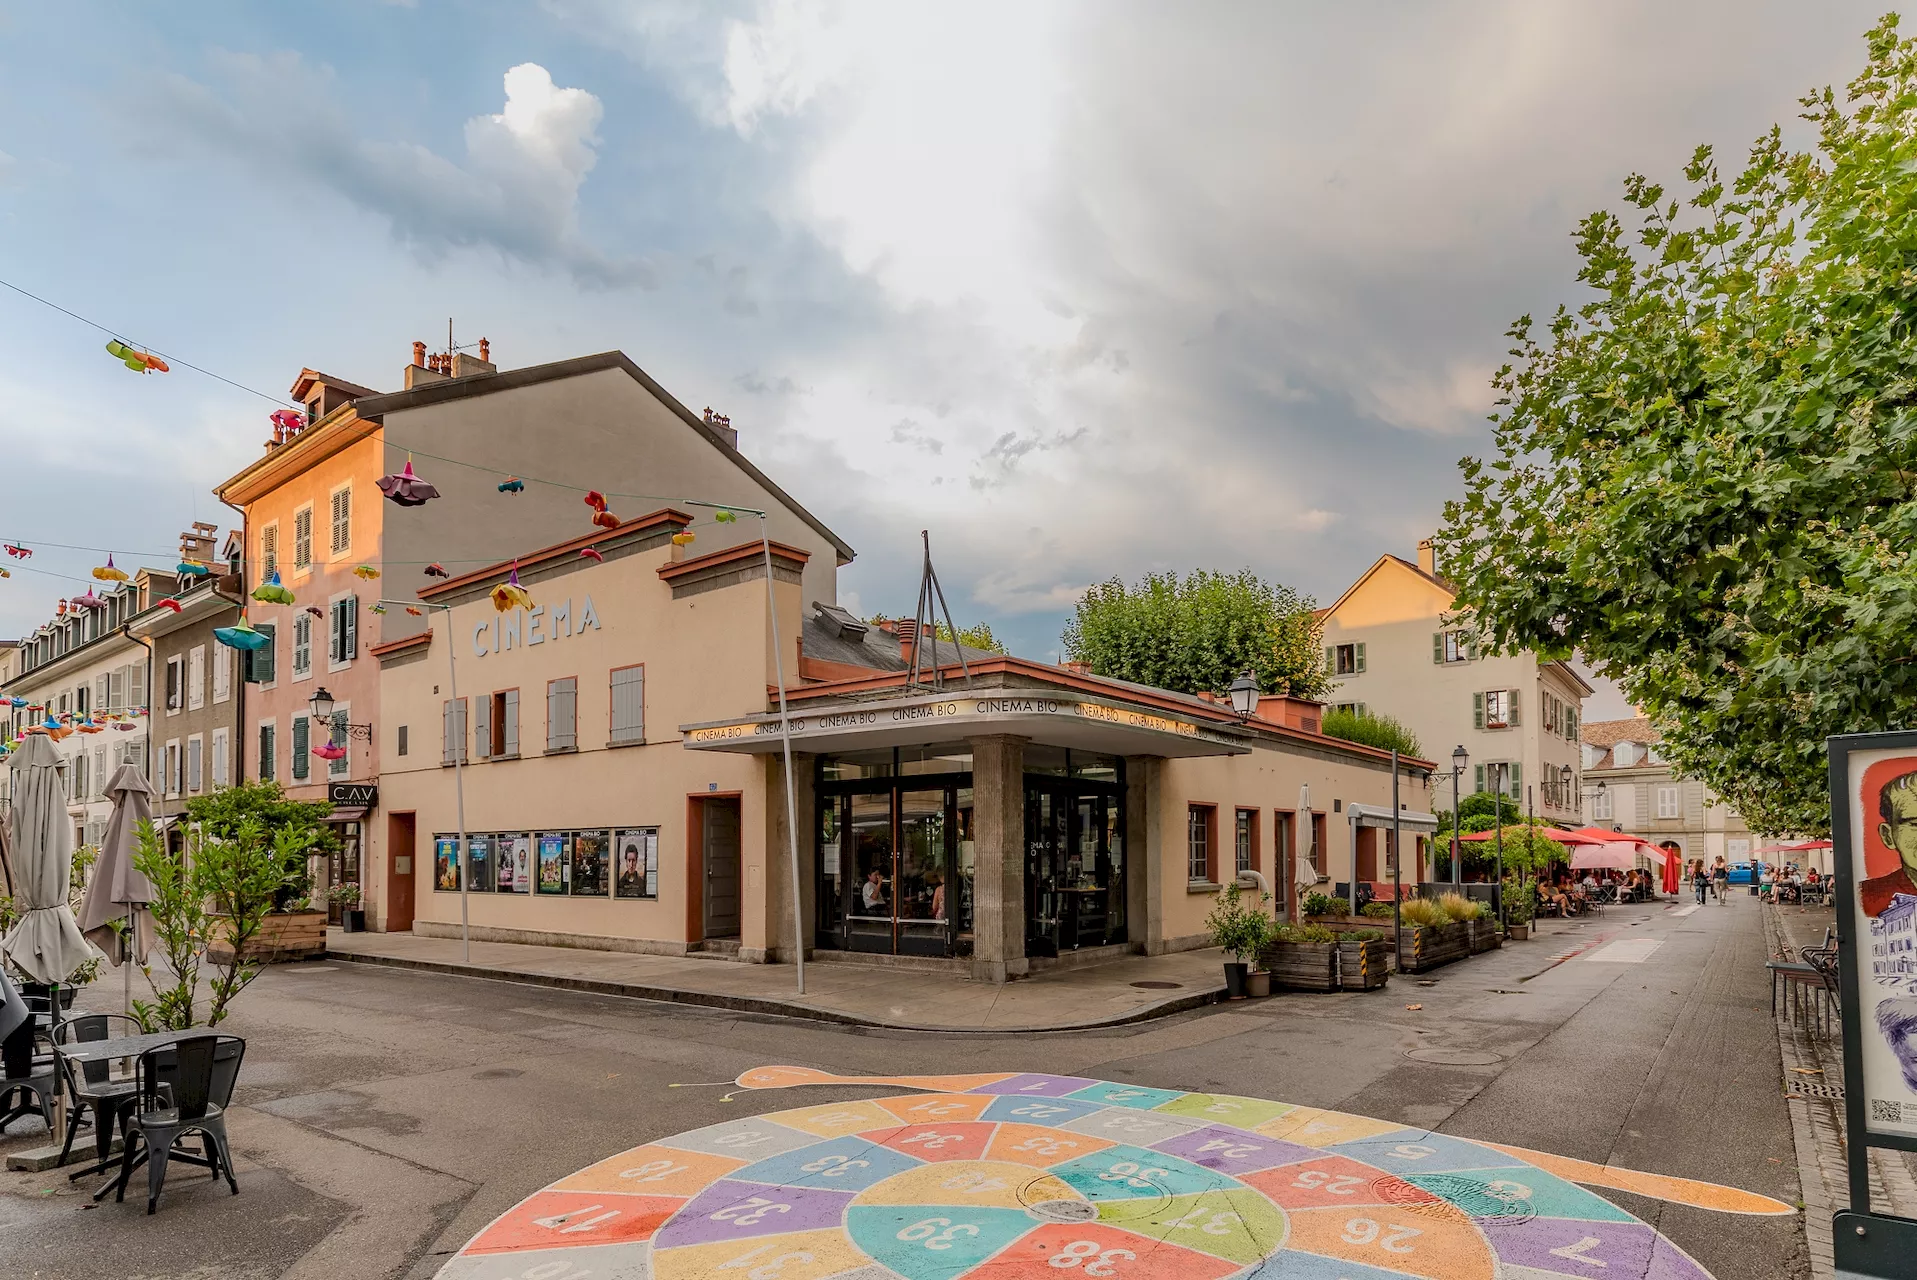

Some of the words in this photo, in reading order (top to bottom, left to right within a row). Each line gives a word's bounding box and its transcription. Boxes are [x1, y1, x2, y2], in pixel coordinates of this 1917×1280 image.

[472, 594, 601, 657] CINEMA
[892, 706, 934, 721] CINEMA
[937, 703, 957, 716] BIO
[975, 701, 1033, 714] CINEMA
[1037, 702, 1058, 713] BIO
[1073, 703, 1106, 719] CINEMA
[1106, 709, 1120, 722] BIO
[789, 720, 806, 731] BIO
[819, 715, 857, 728] CINEMA
[860, 712, 877, 724] BIO
[1128, 714, 1155, 730] CINEMA
[1155, 720, 1167, 731] BIO
[696, 729, 727, 742] CINEMA
[728, 727, 742, 738] BIO
[1020, 1081, 1050, 1091] 1
[1103, 1090, 1149, 1101] 2
[908, 1100, 970, 1115] 21
[1010, 1103, 1071, 1118] 22
[1203, 1102, 1243, 1114] 3
[1103, 1116, 1166, 1132] 23
[714, 1131, 776, 1148] 19
[899, 1130, 965, 1149] 34
[1011, 1136, 1078, 1155] 35
[1195, 1138, 1262, 1159] 24
[1385, 1144, 1437, 1161] 5
[618, 1160, 689, 1183] 18
[800, 1155, 870, 1177] 33
[1099, 1162, 1169, 1188] 36
[1290, 1170, 1366, 1195] 25
[531, 1203, 622, 1234] 17
[709, 1197, 792, 1226] 32
[1161, 1207, 1242, 1235] 37
[896, 1217, 980, 1250] 39
[1340, 1217, 1424, 1253] 26
[716, 1243, 816, 1280] 31
[1048, 1240, 1137, 1277] 38
[1549, 1236, 1608, 1268] 7
